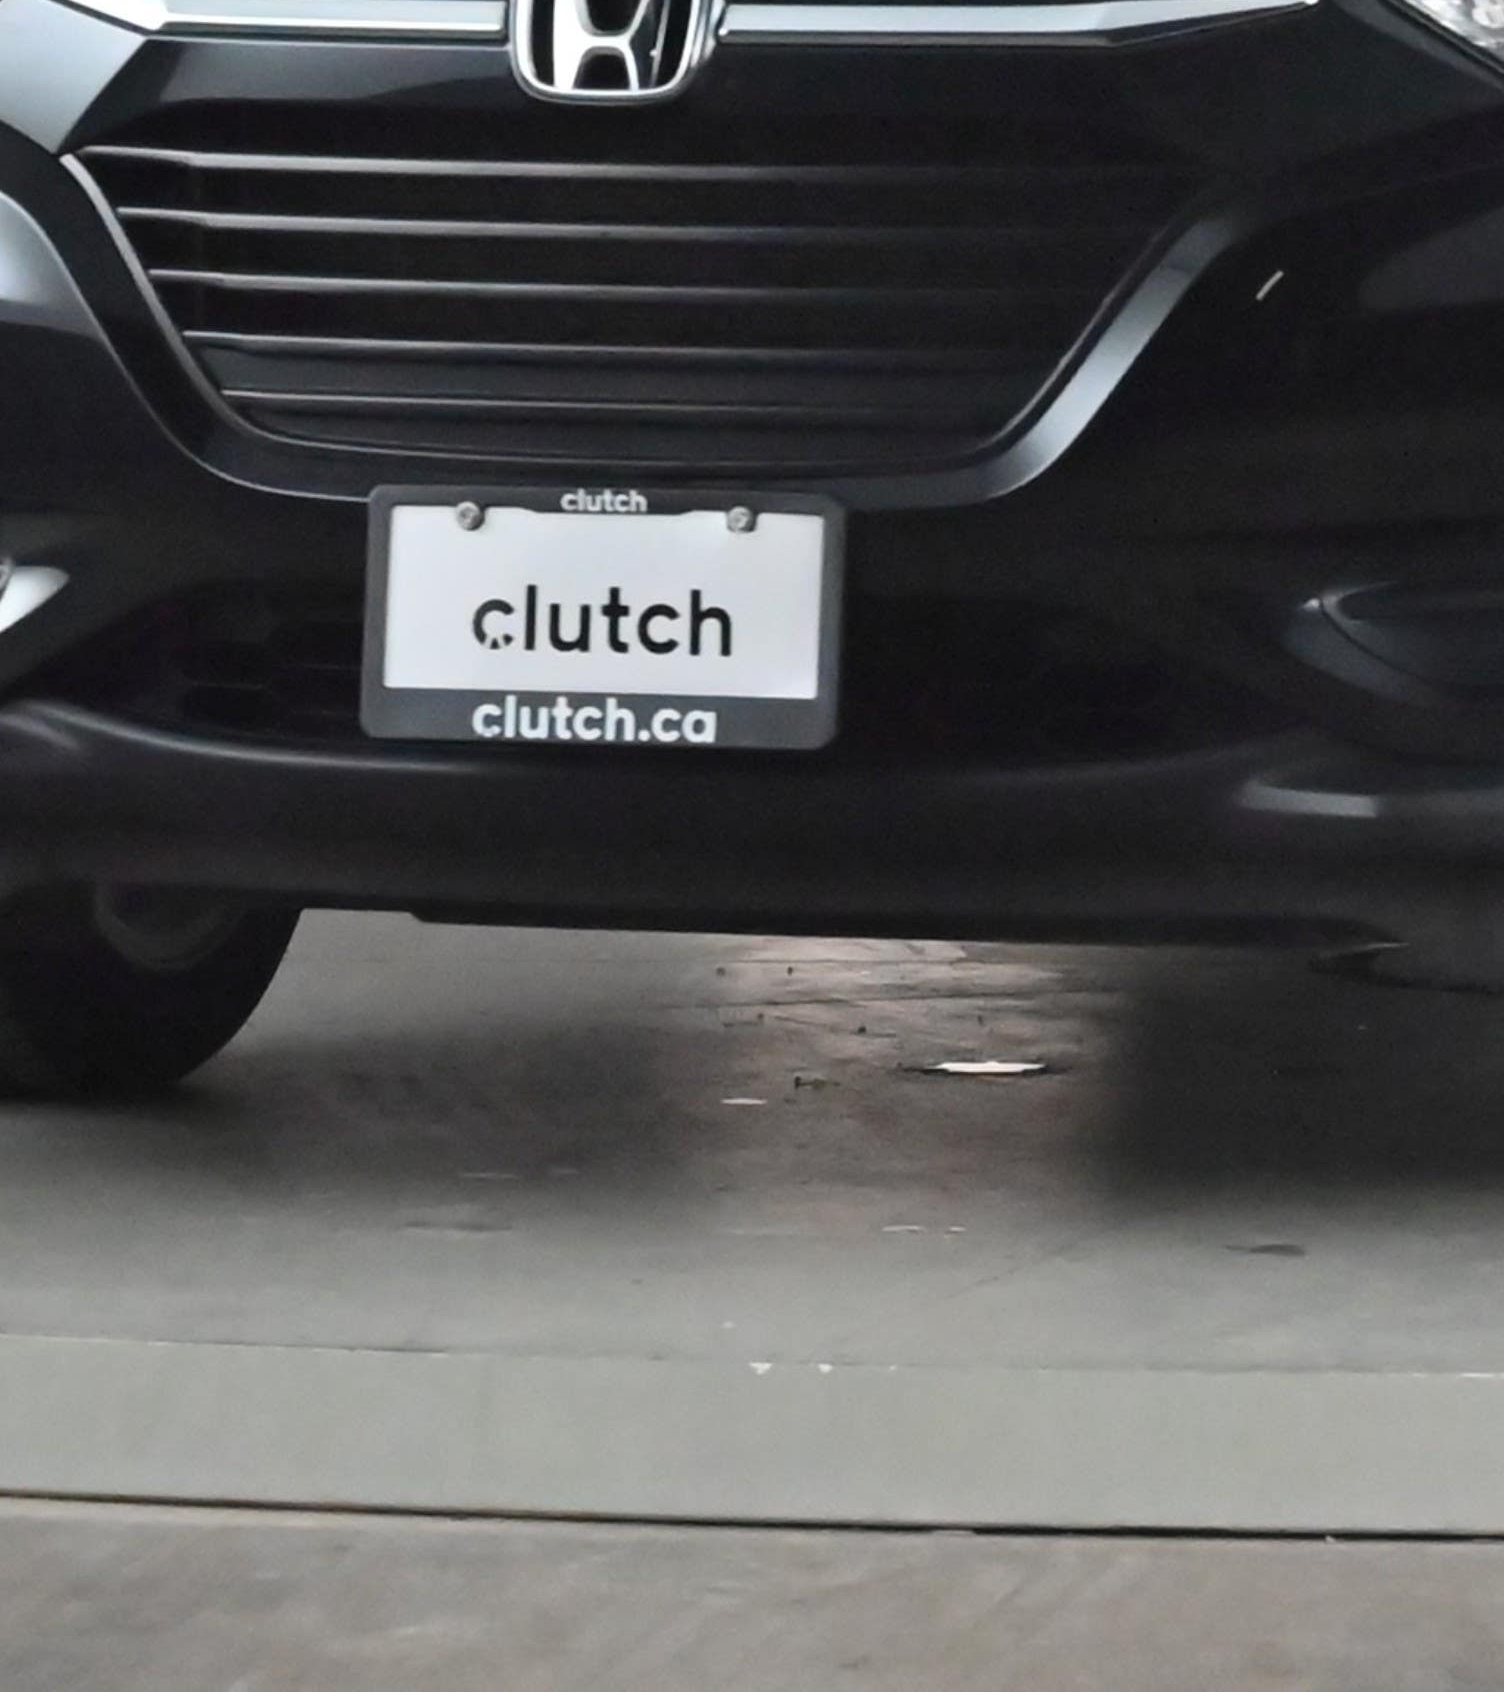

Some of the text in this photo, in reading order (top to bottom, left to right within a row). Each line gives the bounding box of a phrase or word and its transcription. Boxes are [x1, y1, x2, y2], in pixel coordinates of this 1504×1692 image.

[560, 488, 648, 513] clutch
[472, 585, 732, 657] clutch
[472, 694, 717, 744] clutch.ca
